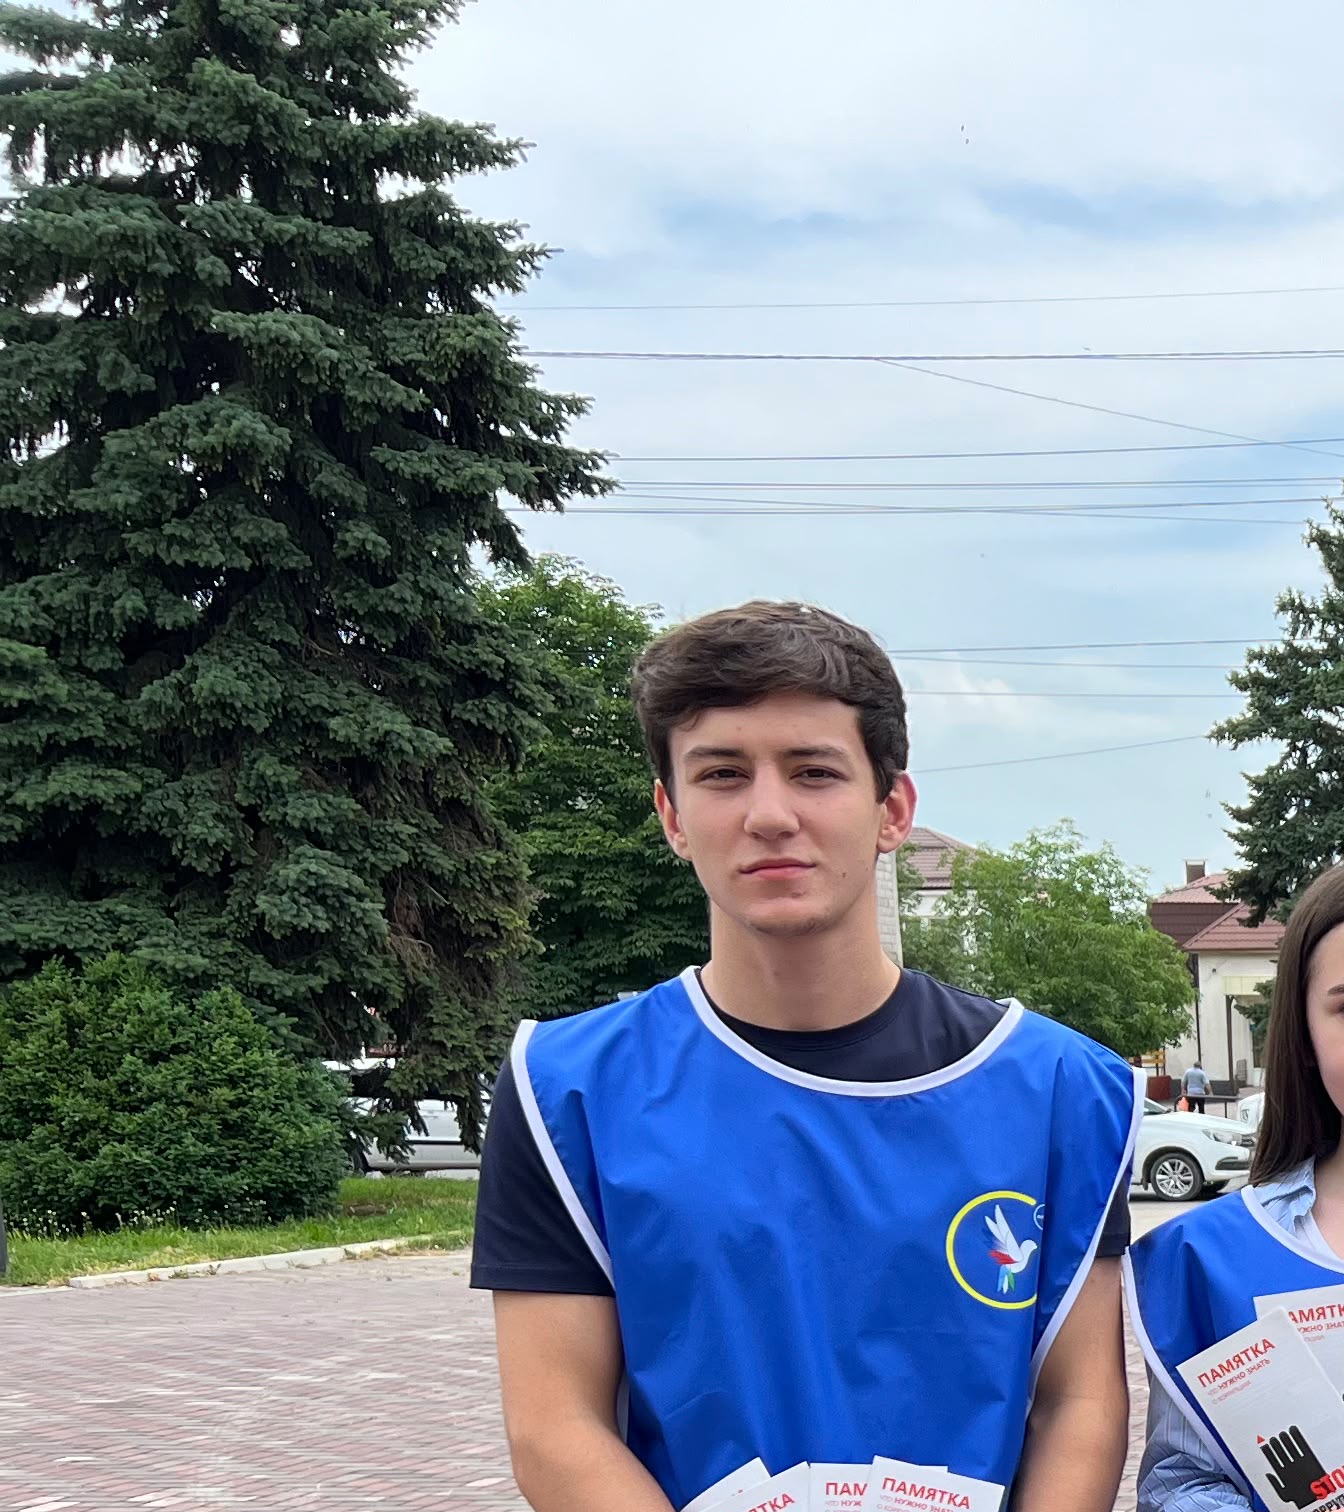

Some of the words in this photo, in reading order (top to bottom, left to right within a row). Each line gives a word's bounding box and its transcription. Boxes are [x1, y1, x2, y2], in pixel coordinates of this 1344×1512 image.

[1197, 1338, 1276, 1388] ПАМЯТКА
[1218, 1371, 1246, 1389] НУЖНО
[881, 1476, 971, 1509] ПАМЯТКА
[894, 1497, 928, 1510] НУЖНО
